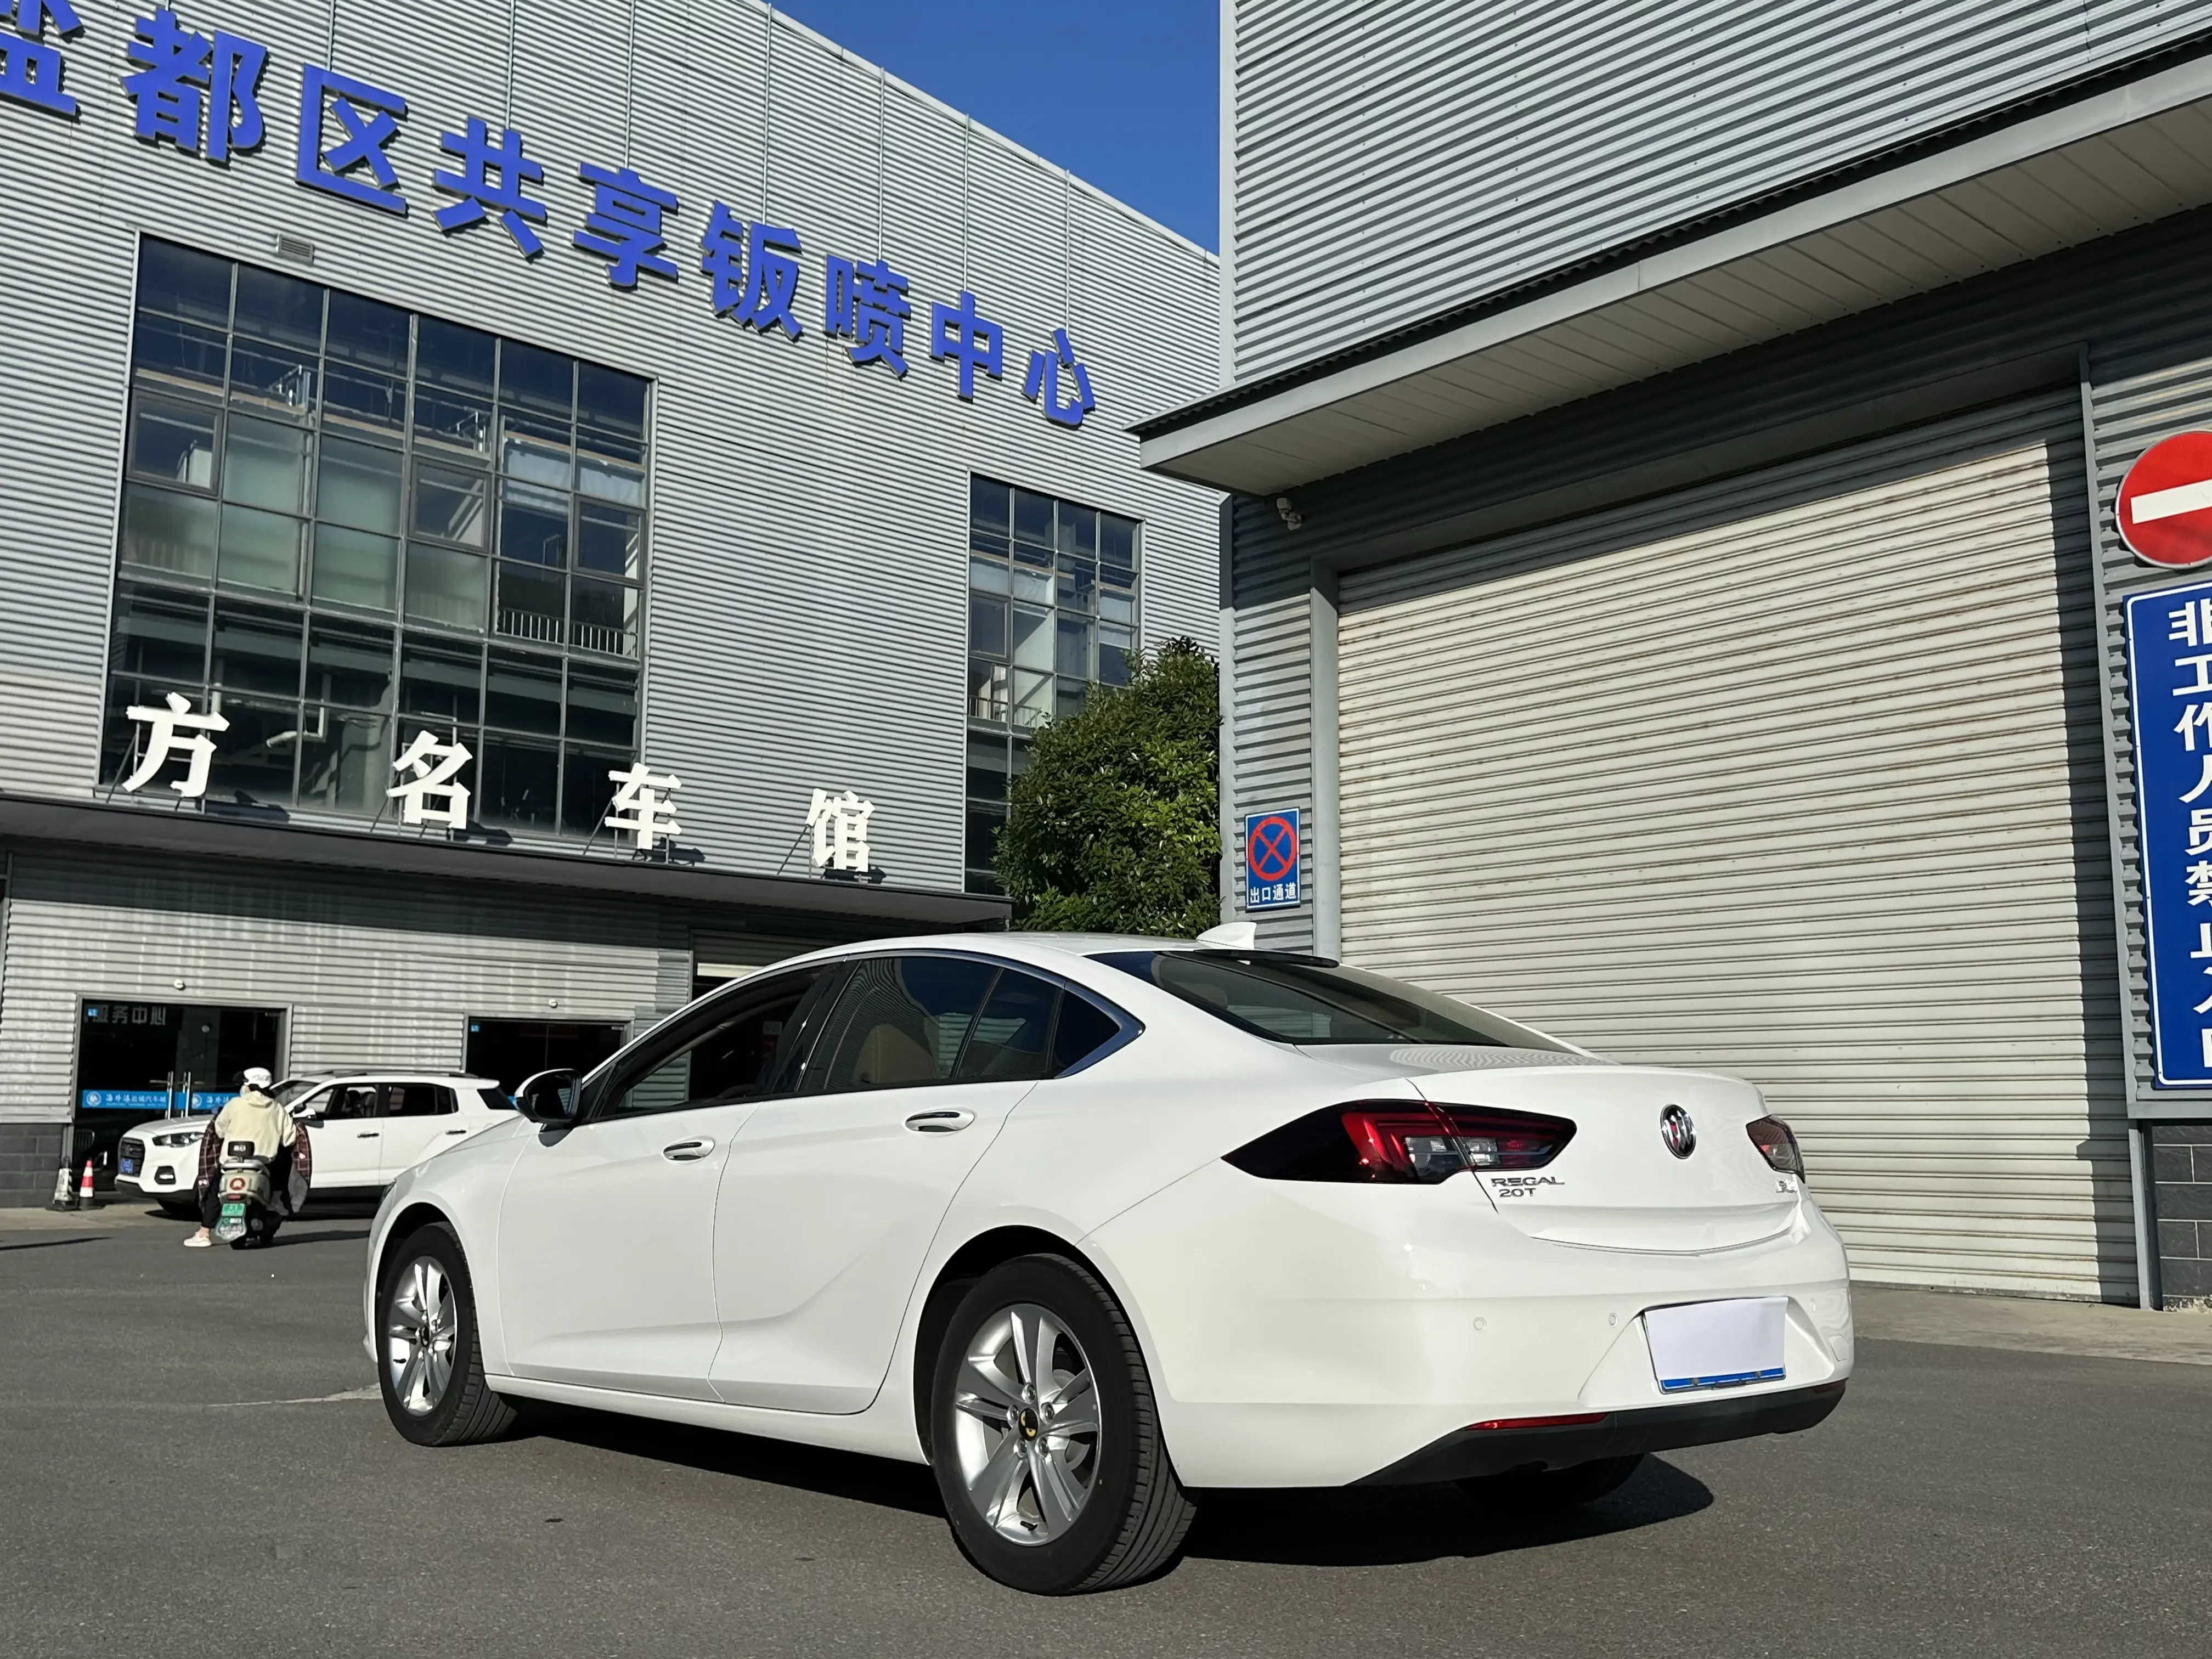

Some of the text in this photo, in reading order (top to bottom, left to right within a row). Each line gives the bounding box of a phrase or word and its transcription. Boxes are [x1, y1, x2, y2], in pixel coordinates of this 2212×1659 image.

[122, 692, 874, 873] 方名车馆
[1250, 882, 1296, 904] 出口通道
[1491, 1176, 1565, 1187] REGAL
[1499, 1188, 1536, 1198] 20T
